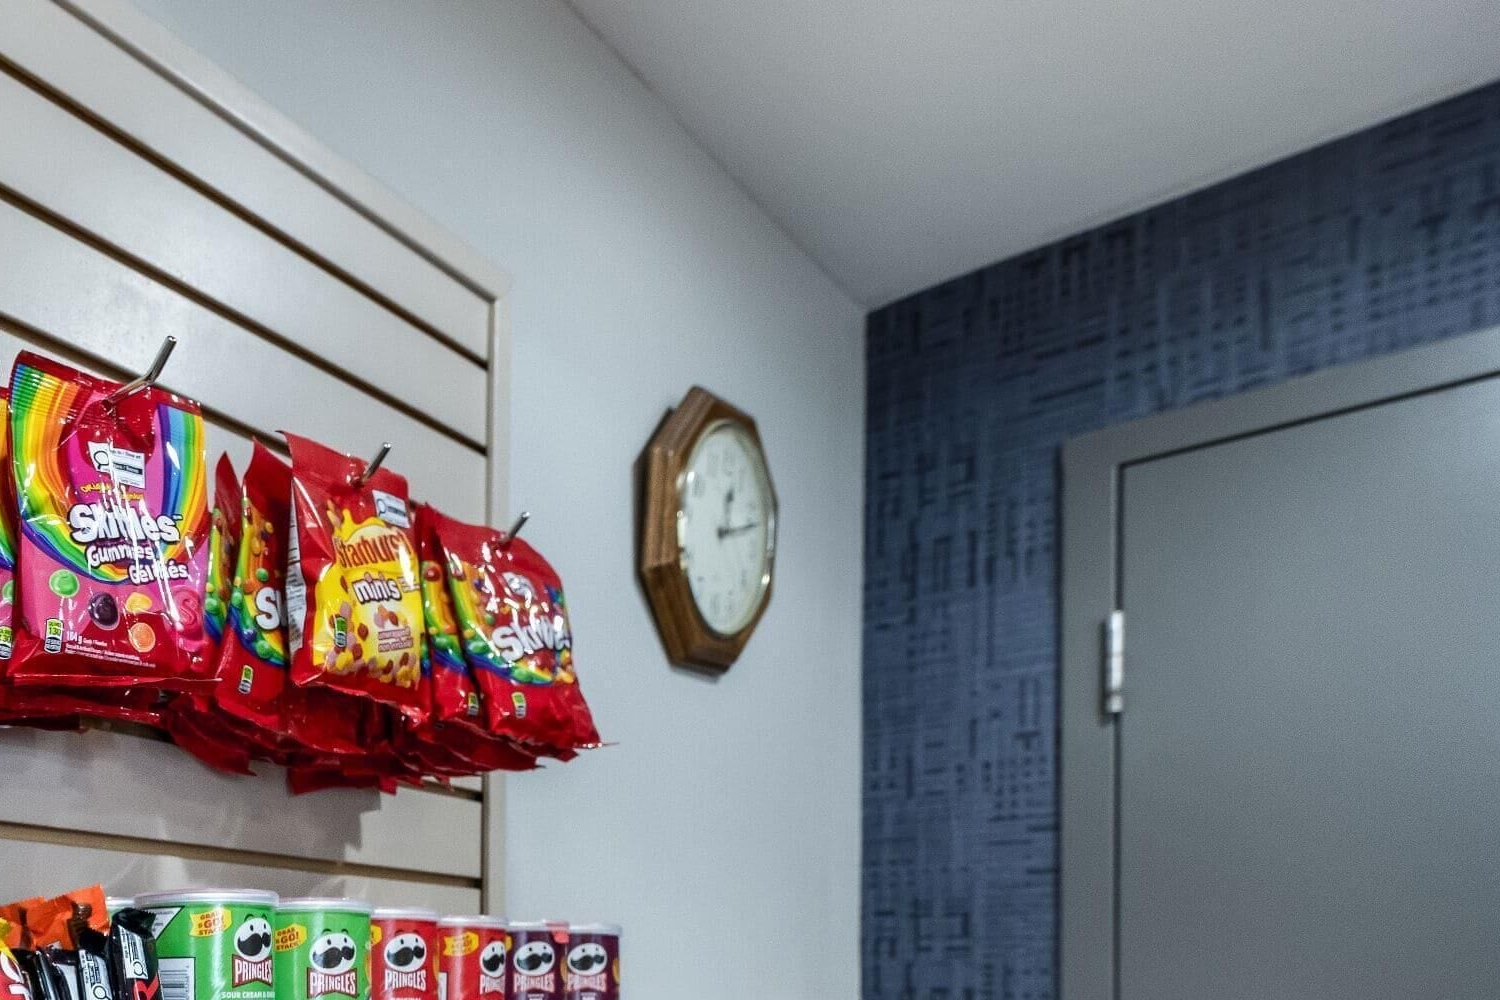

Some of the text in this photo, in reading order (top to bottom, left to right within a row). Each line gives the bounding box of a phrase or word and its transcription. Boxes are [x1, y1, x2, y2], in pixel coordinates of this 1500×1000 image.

[351, 573, 403, 605] minis
[234, 958, 272, 984] PRINGLES
[310, 971, 356, 995] PRINGLES
[385, 970, 426, 992] PRINGLES
[513, 973, 555, 993] PRINGLES
